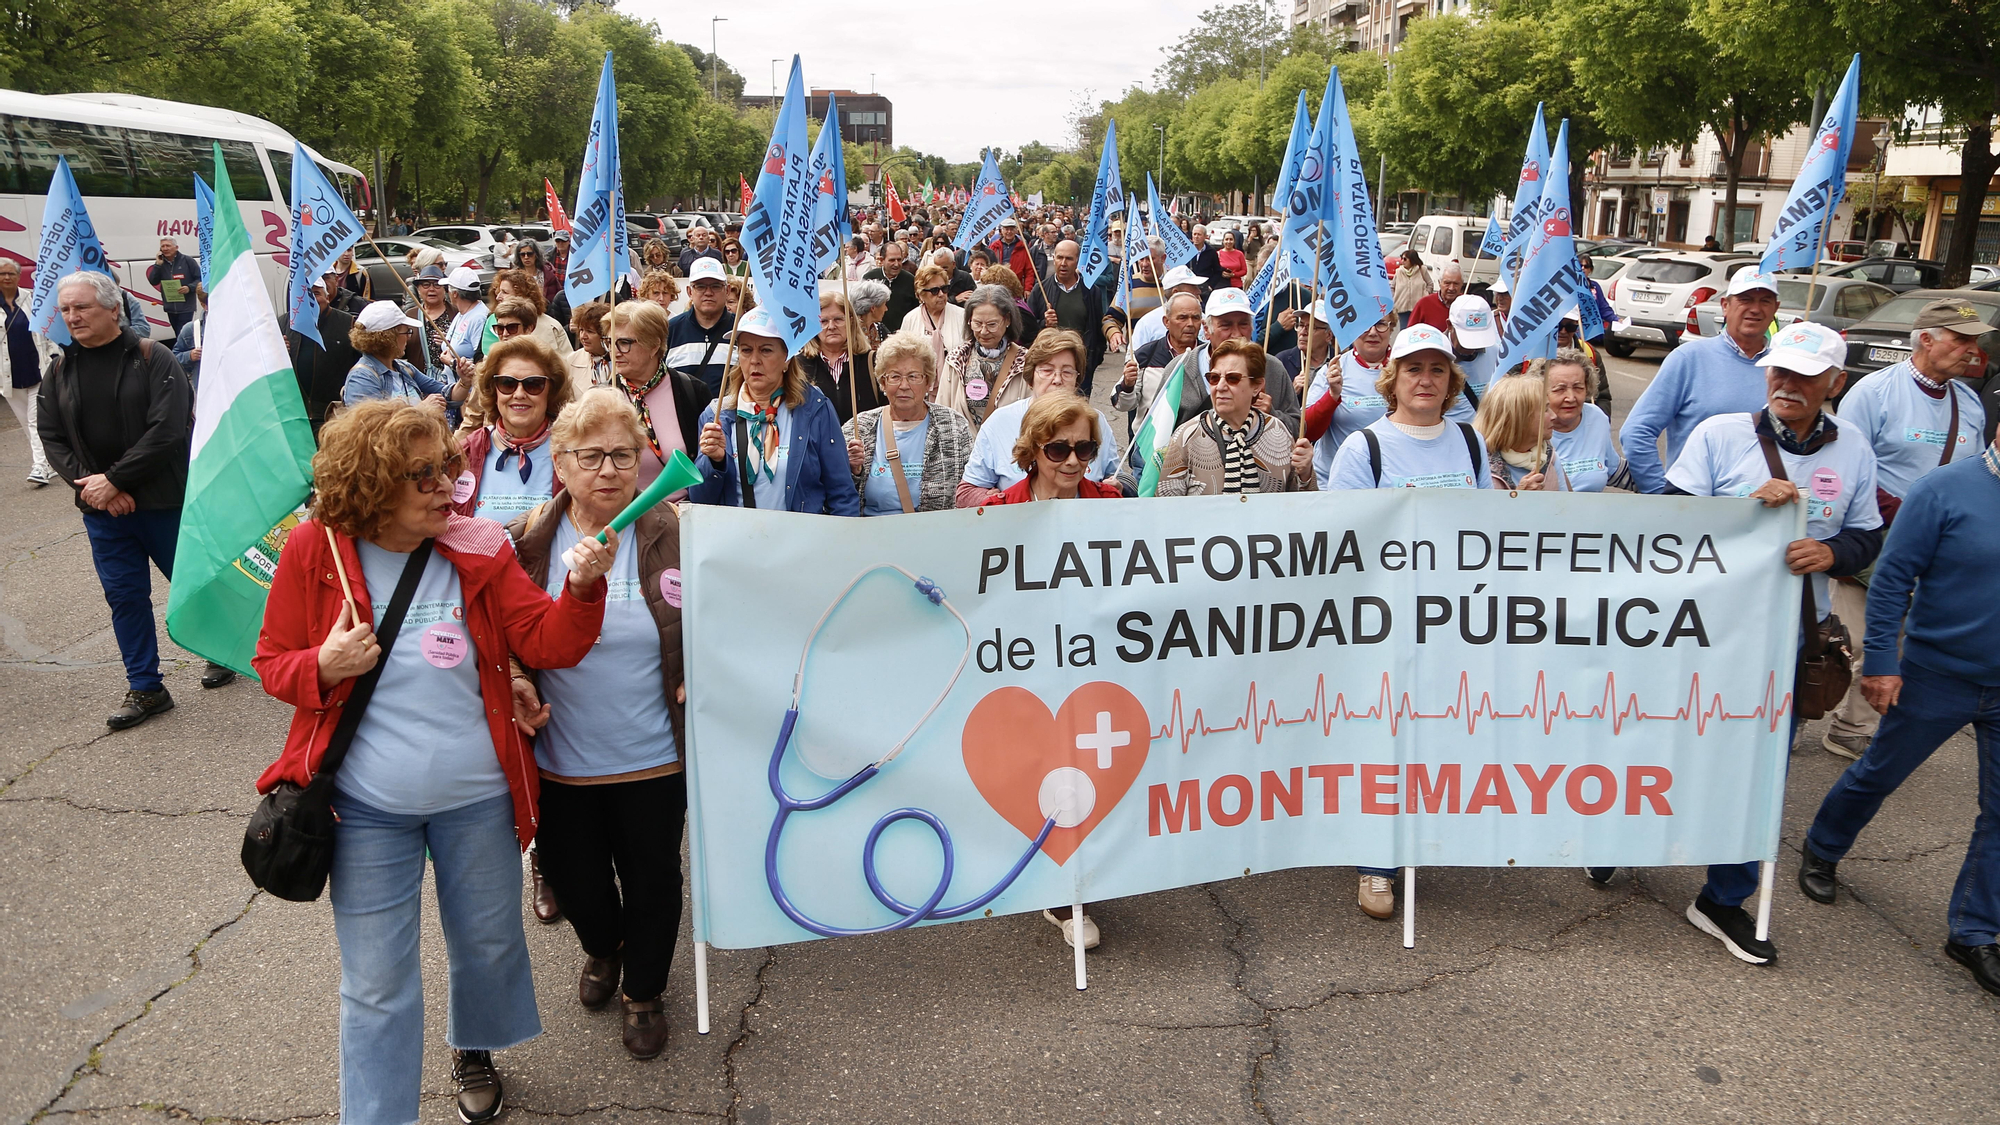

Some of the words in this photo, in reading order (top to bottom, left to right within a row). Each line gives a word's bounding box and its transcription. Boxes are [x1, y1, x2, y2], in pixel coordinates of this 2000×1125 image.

[1157, 209, 1190, 252] PLATAFORMA
[1171, 242, 1178, 250] de
[1635, 292, 1650, 301] 9215
[1876, 350, 1899, 360] 5259
[253, 553, 272, 571] POR
[978, 530, 1364, 594] PLATAFORMA
[1380, 539, 1436, 571] en
[1458, 530, 1727, 573] DEFENSA
[248, 562, 258, 573] LA
[417, 602, 454, 610] MONTEMAYOR
[415, 615, 443, 624] PÚBLICA
[976, 627, 1035, 673] de
[1054, 624, 1096, 667] la
[1116, 596, 1392, 663] SANIDAD
[1416, 584, 1710, 648] PÚBLICA
[436, 636, 454, 644] MATA
[1148, 763, 1674, 837] MONTEMAYOR
